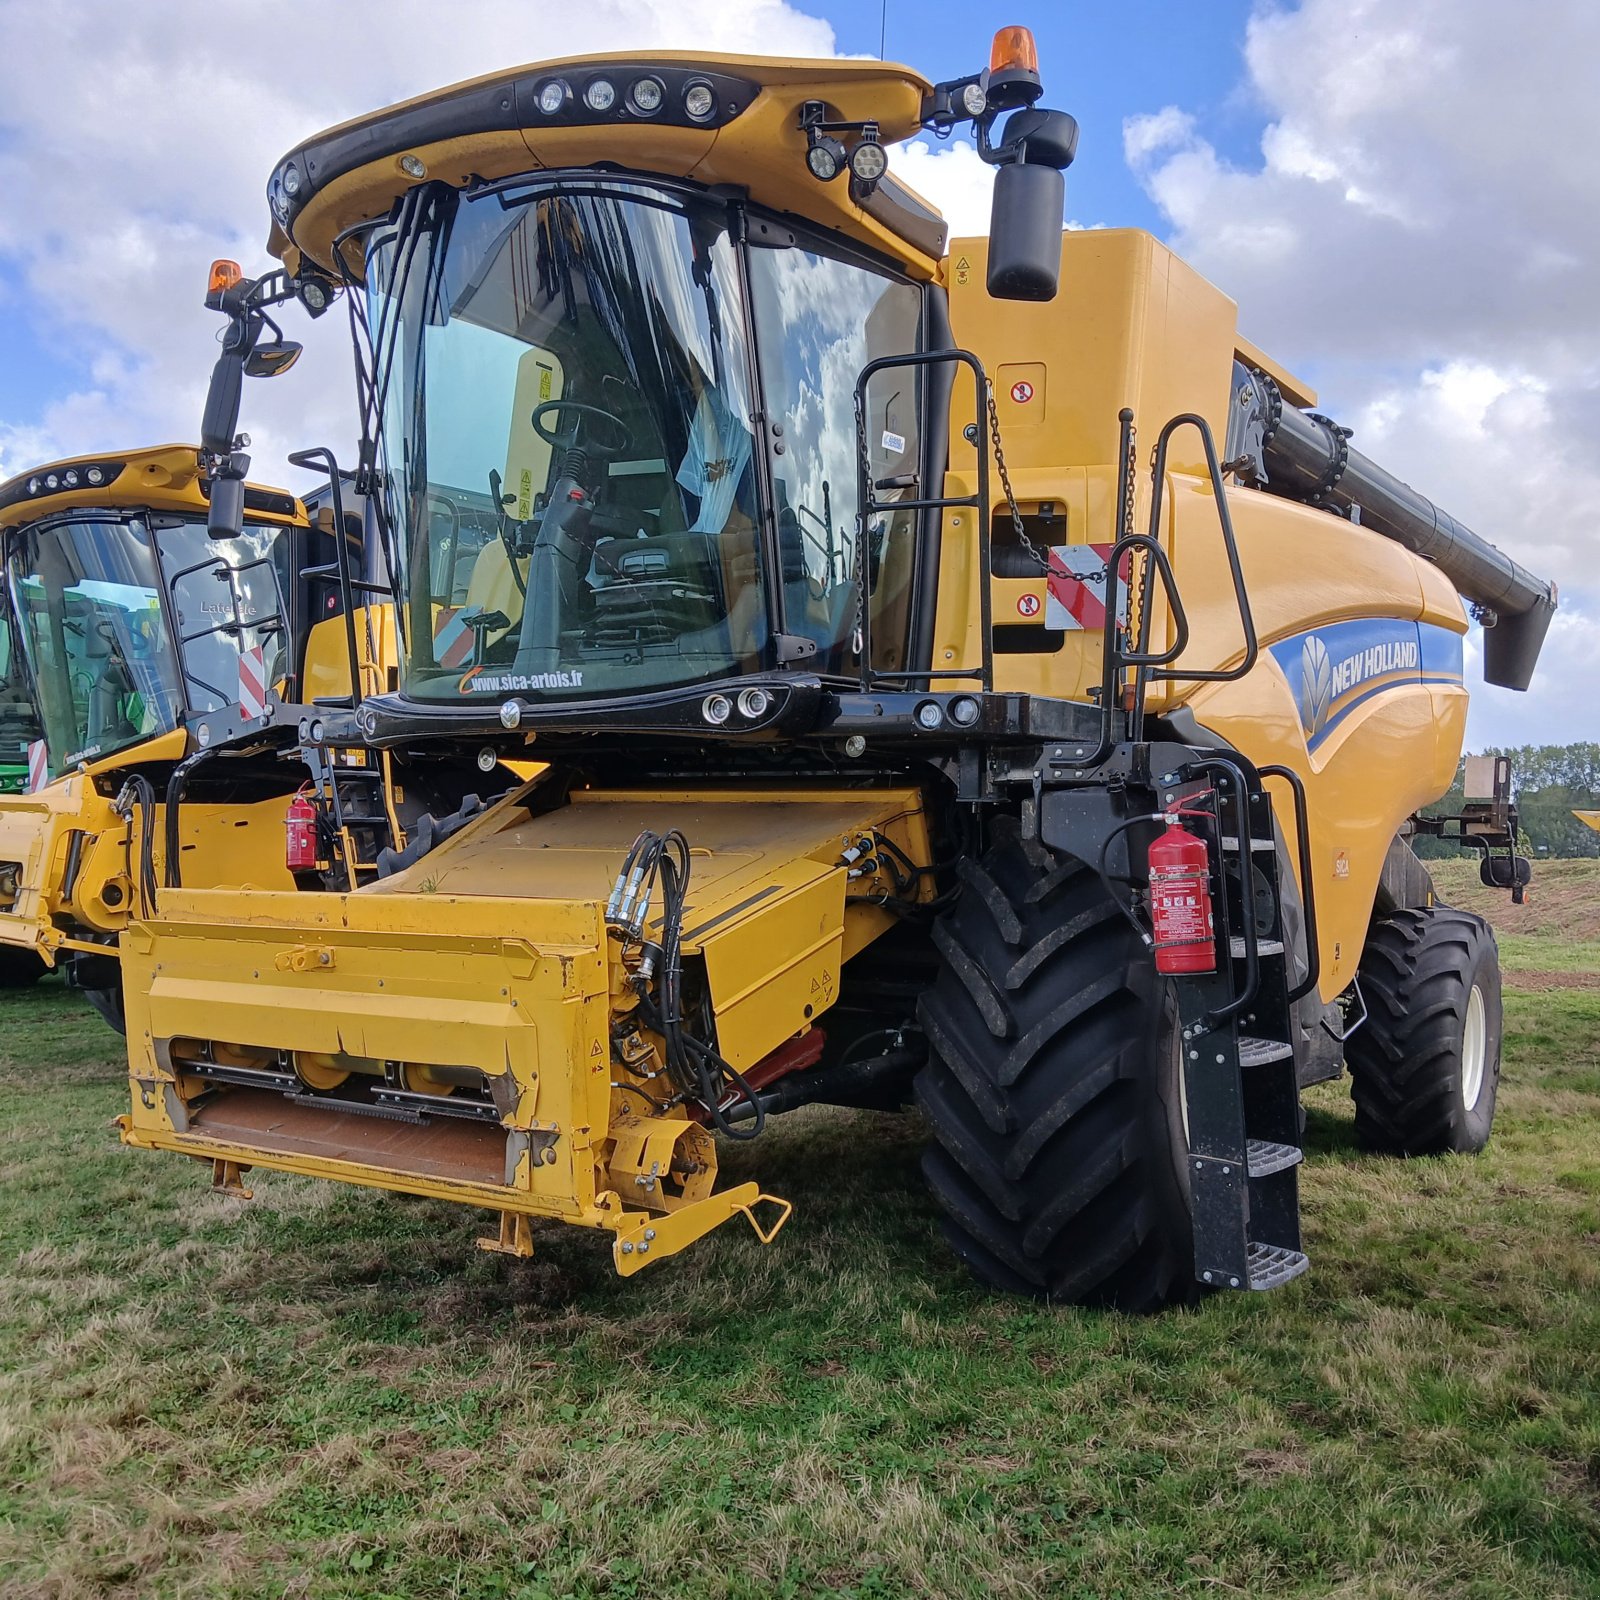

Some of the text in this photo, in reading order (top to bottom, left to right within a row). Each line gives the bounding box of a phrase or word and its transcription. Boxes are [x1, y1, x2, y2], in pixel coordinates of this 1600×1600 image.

[200, 601, 257, 616] Latele
[472, 669, 583, 692] www.sica-artois.fr
[1331, 641, 1417, 698] NEW HOLLAND
